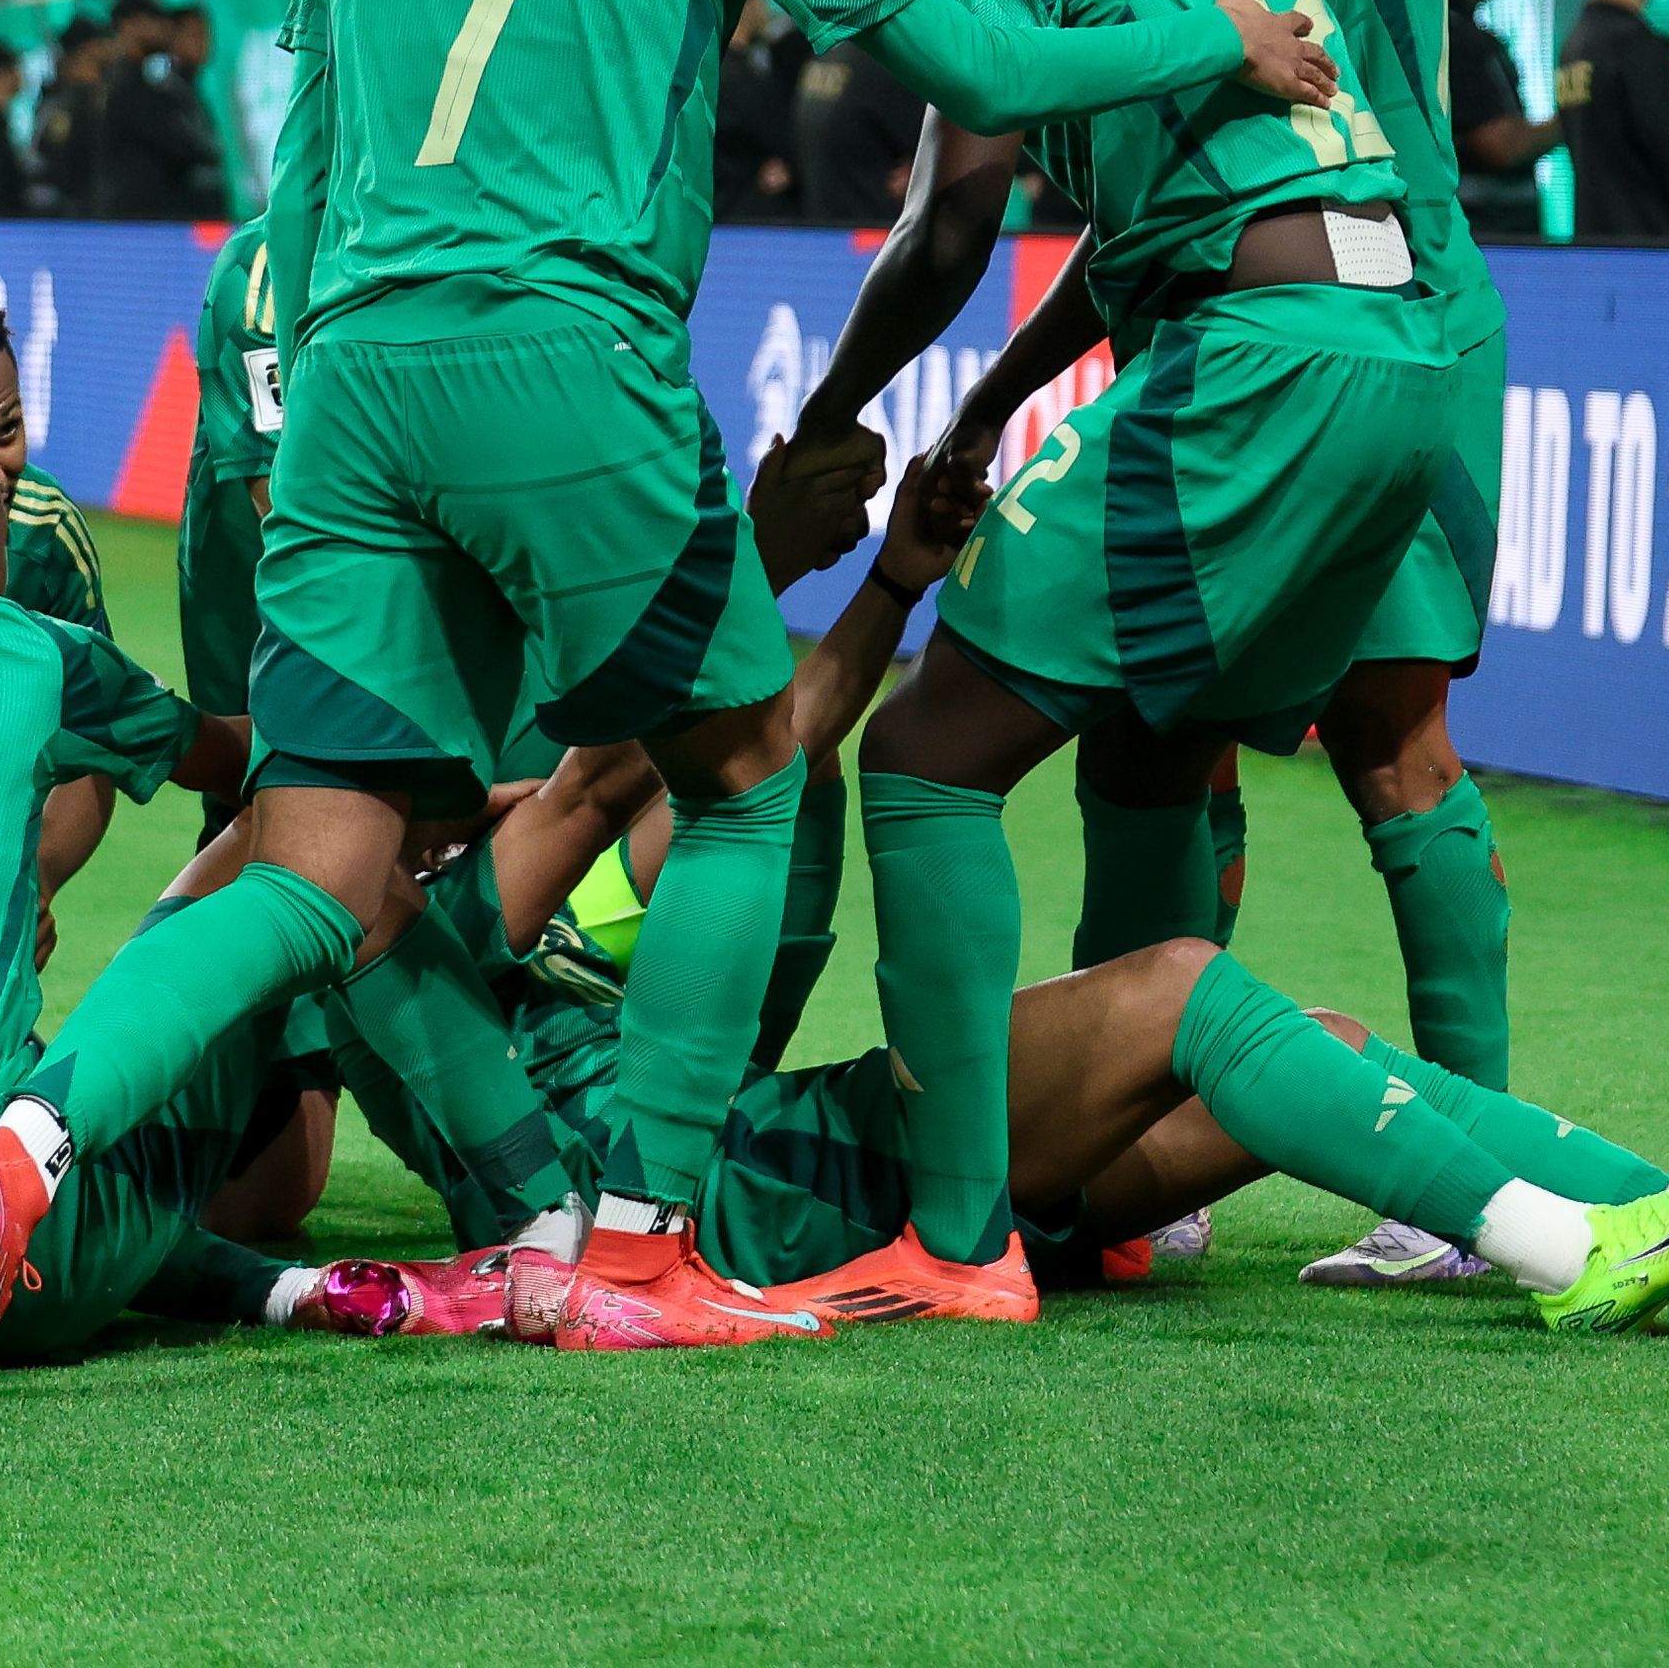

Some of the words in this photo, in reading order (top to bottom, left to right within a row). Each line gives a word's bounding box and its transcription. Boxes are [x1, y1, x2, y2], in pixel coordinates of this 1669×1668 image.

[992, 422, 1082, 536] 2
[1488, 384, 1572, 631] AD
[1583, 388, 1658, 646] TO
